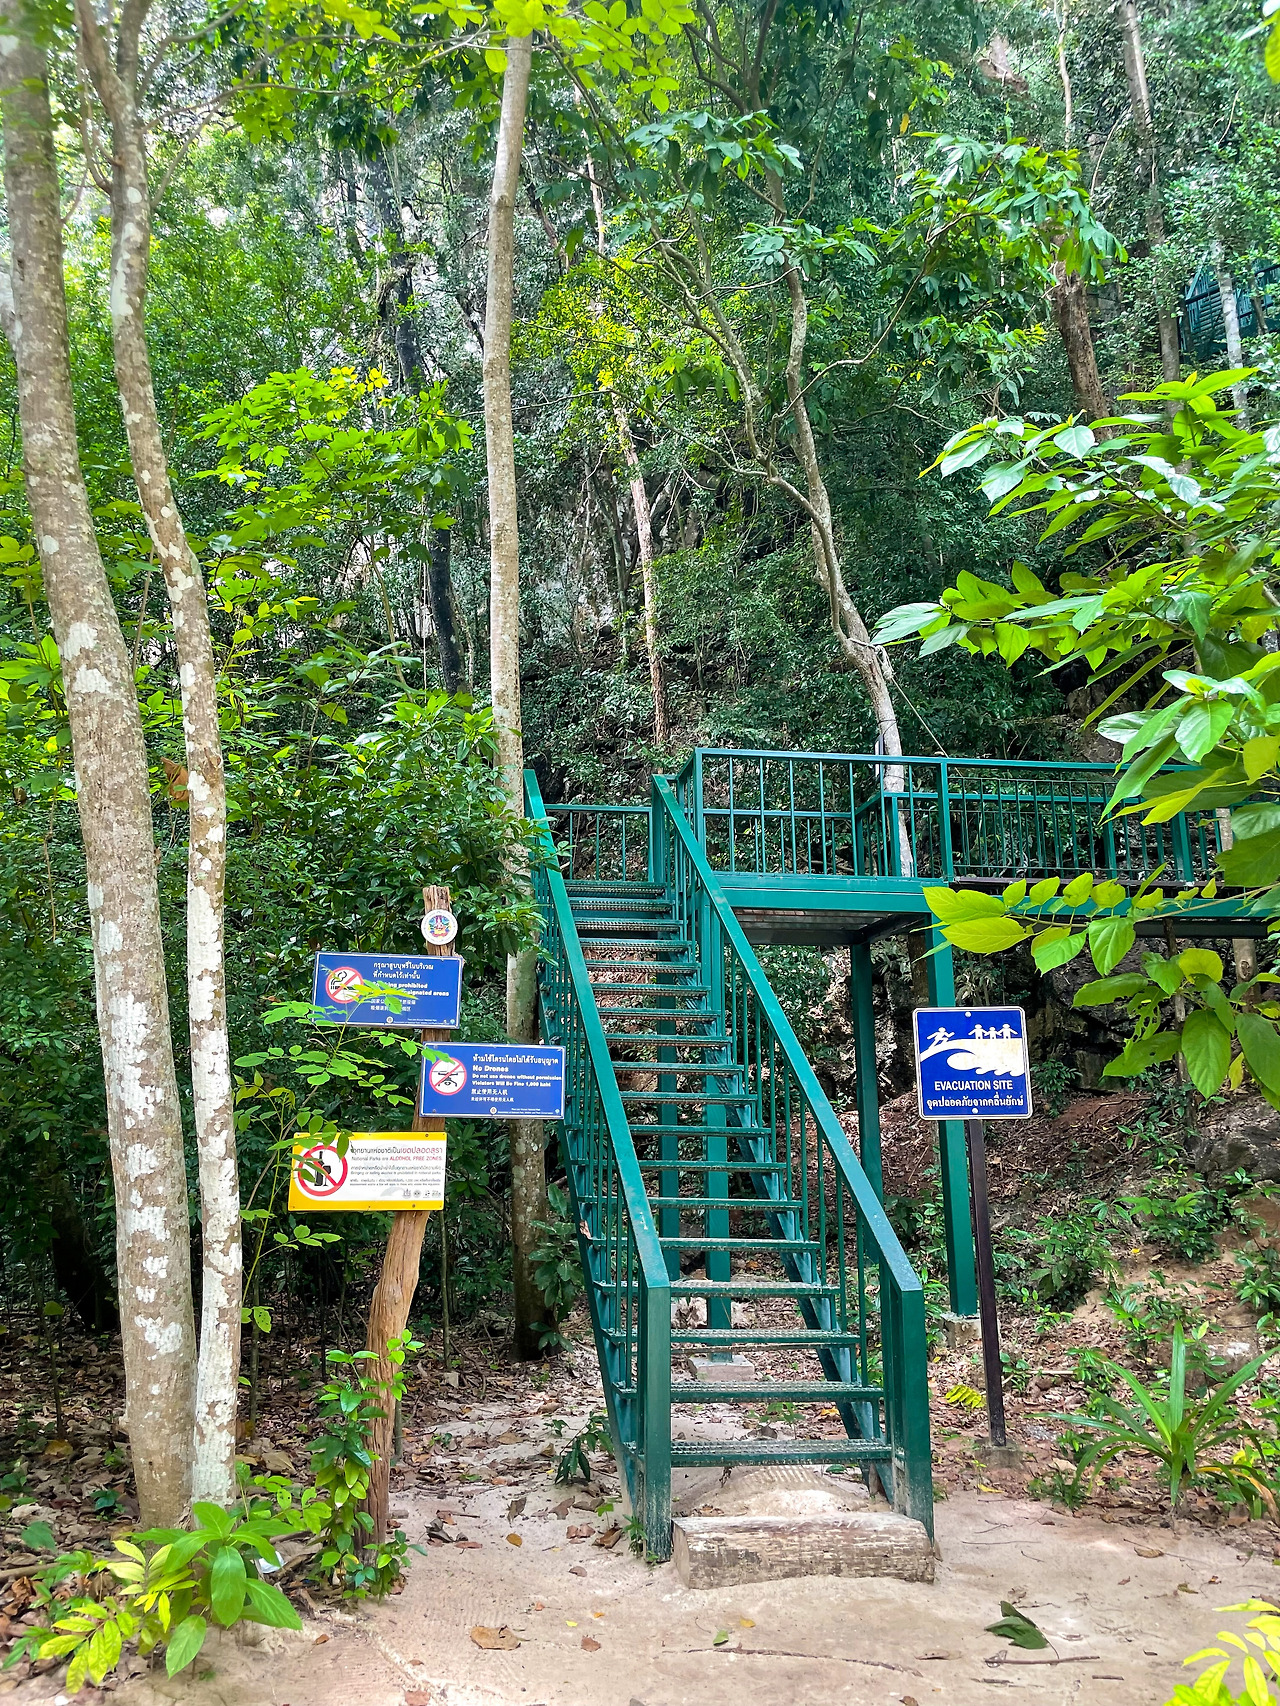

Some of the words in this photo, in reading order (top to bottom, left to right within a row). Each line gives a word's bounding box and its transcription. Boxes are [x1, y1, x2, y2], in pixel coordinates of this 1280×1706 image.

[373, 961, 434, 971] กรุณาสูบบุหรี่ในบริเวณ
[372, 970, 420, 979] ที่กำหนดไว้เท่านั้น
[934, 1080, 991, 1091] EVACUATION
[993, 1080, 1013, 1090] SITE
[926, 1092, 1024, 1110] จุดปลอดภัยจากคลื่นยักษ์
